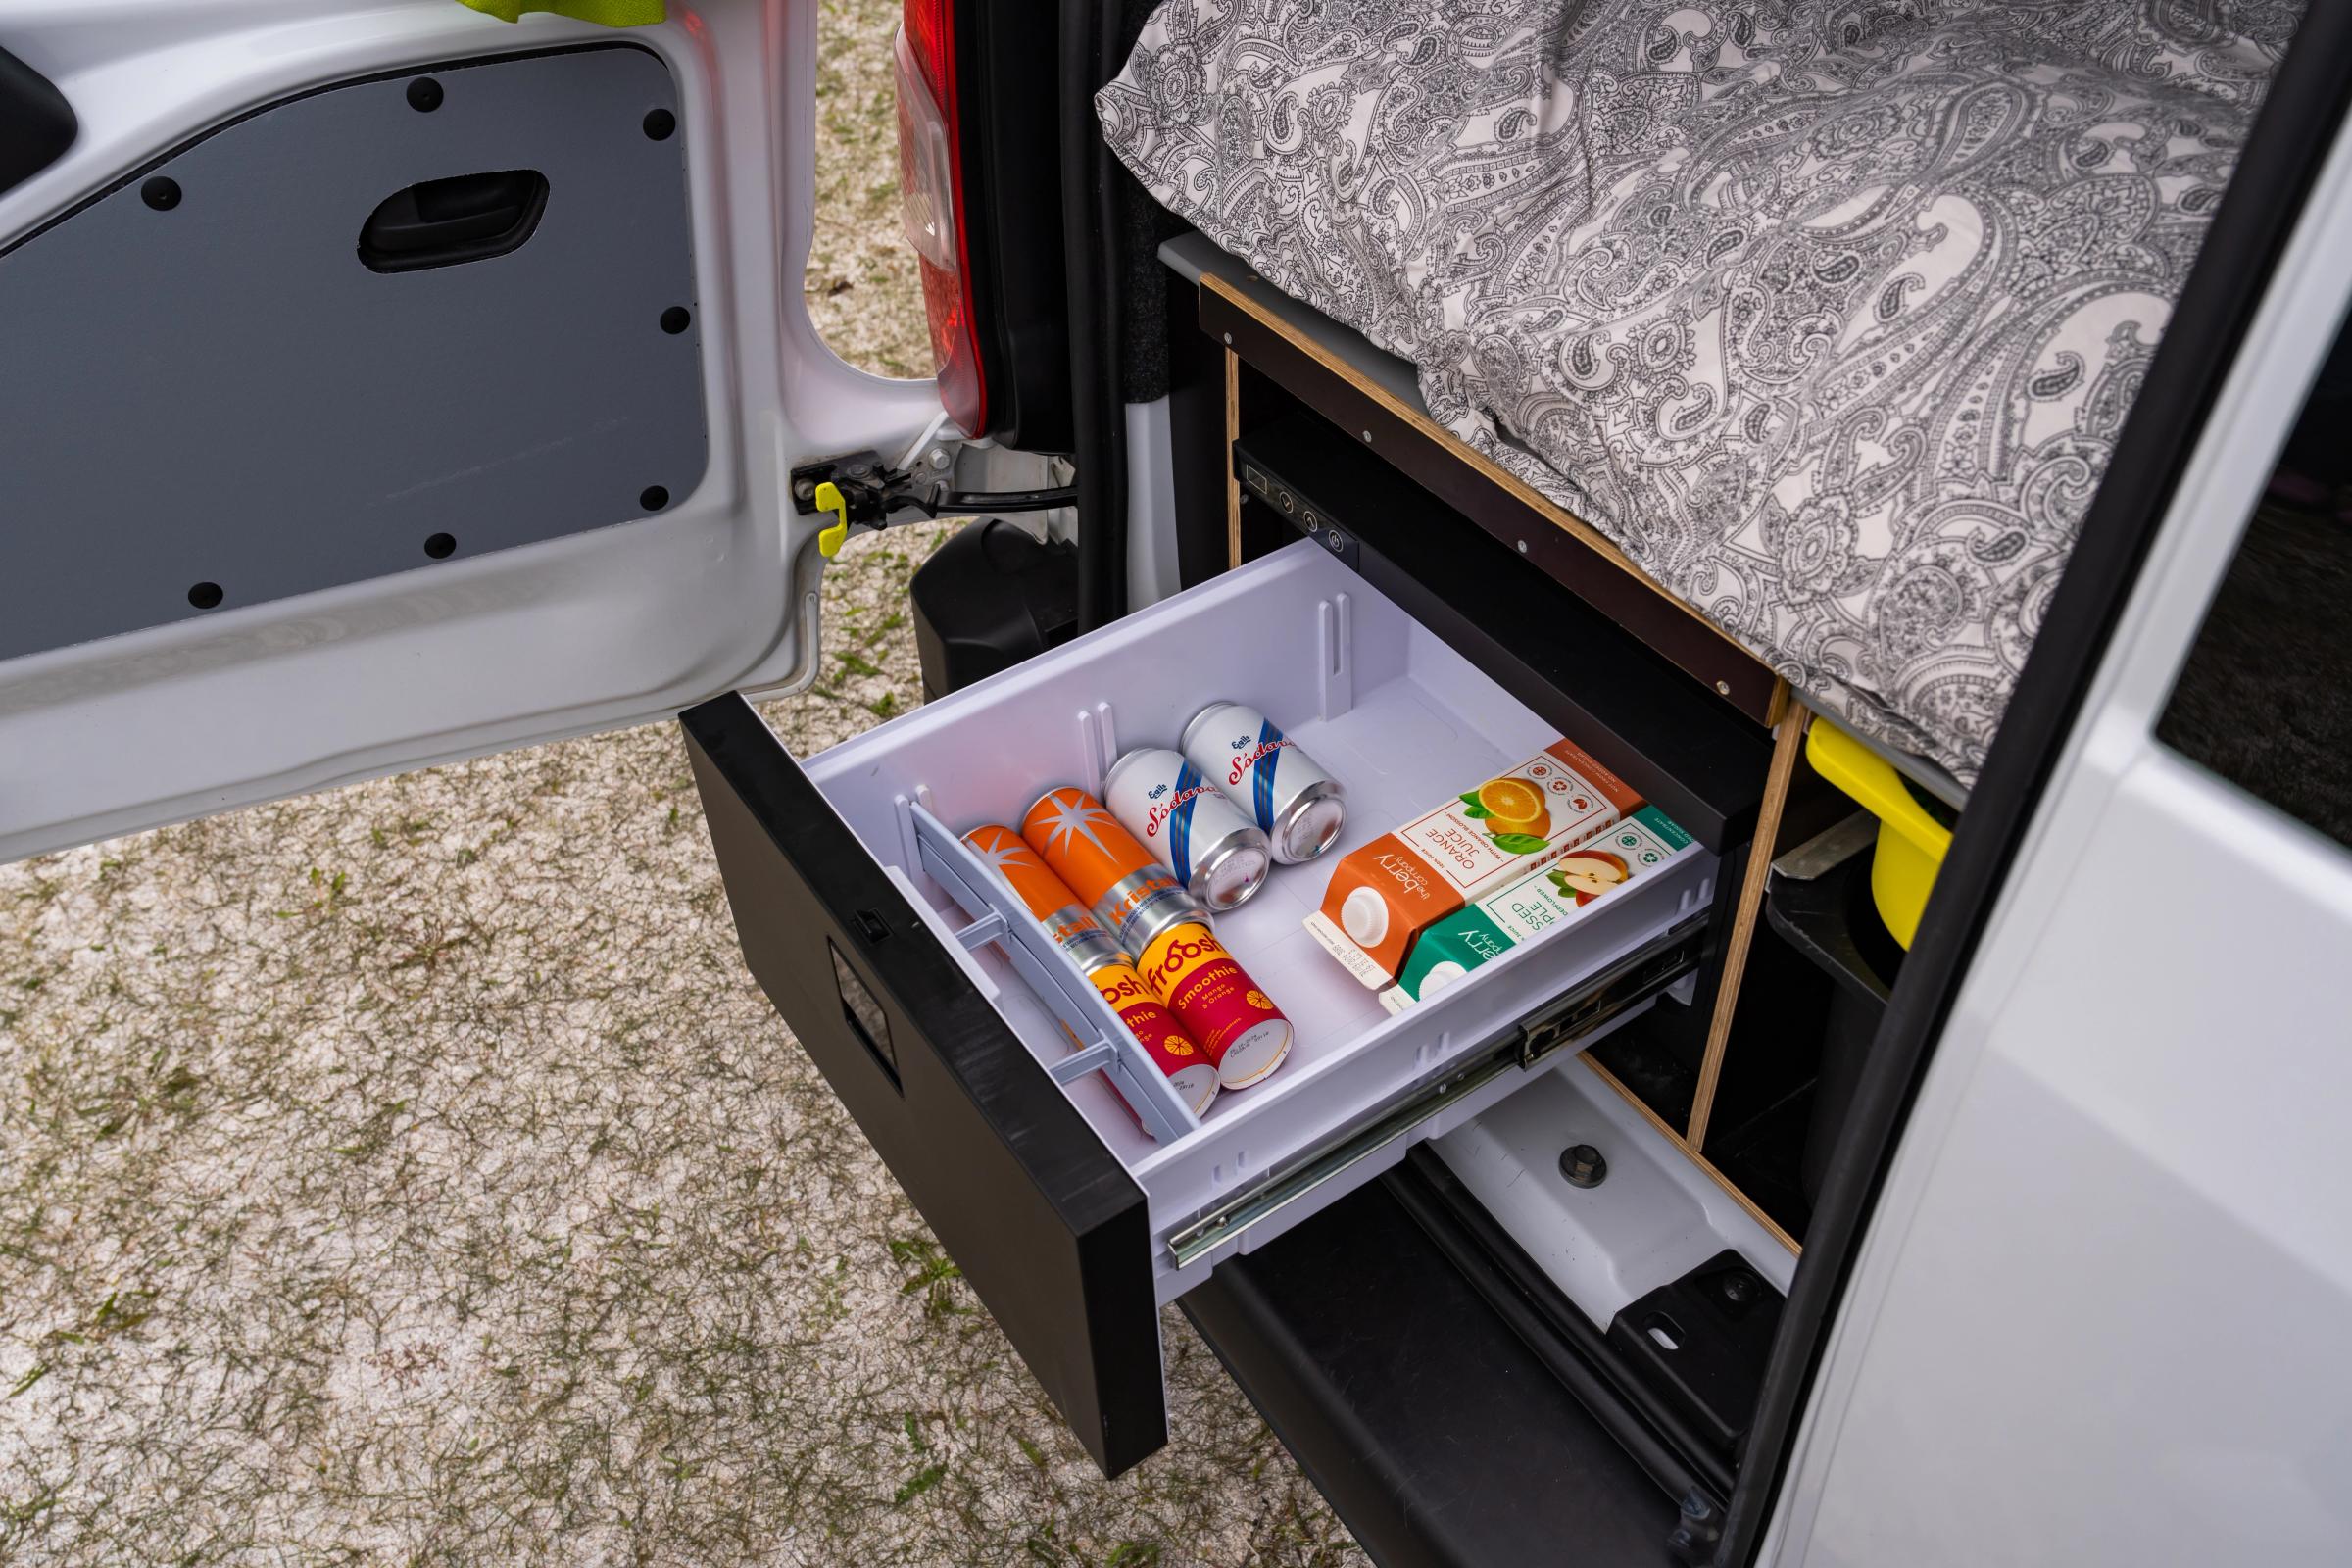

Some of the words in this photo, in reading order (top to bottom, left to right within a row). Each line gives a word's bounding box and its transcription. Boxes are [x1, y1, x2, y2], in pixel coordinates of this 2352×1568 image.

[1232, 736, 1251, 749] Egils
[1148, 784, 1167, 799] Egils
[1425, 828, 1475, 869] ORANGE
[1444, 828, 1480, 857] JUICE
[1372, 854, 1419, 894] berry
[1394, 856, 1428, 886] company
[1416, 885, 1430, 900] the
[1178, 966, 1238, 1010] Smoothie
[1201, 983, 1226, 1002] Mango
[1208, 986, 1235, 1004] Orange
